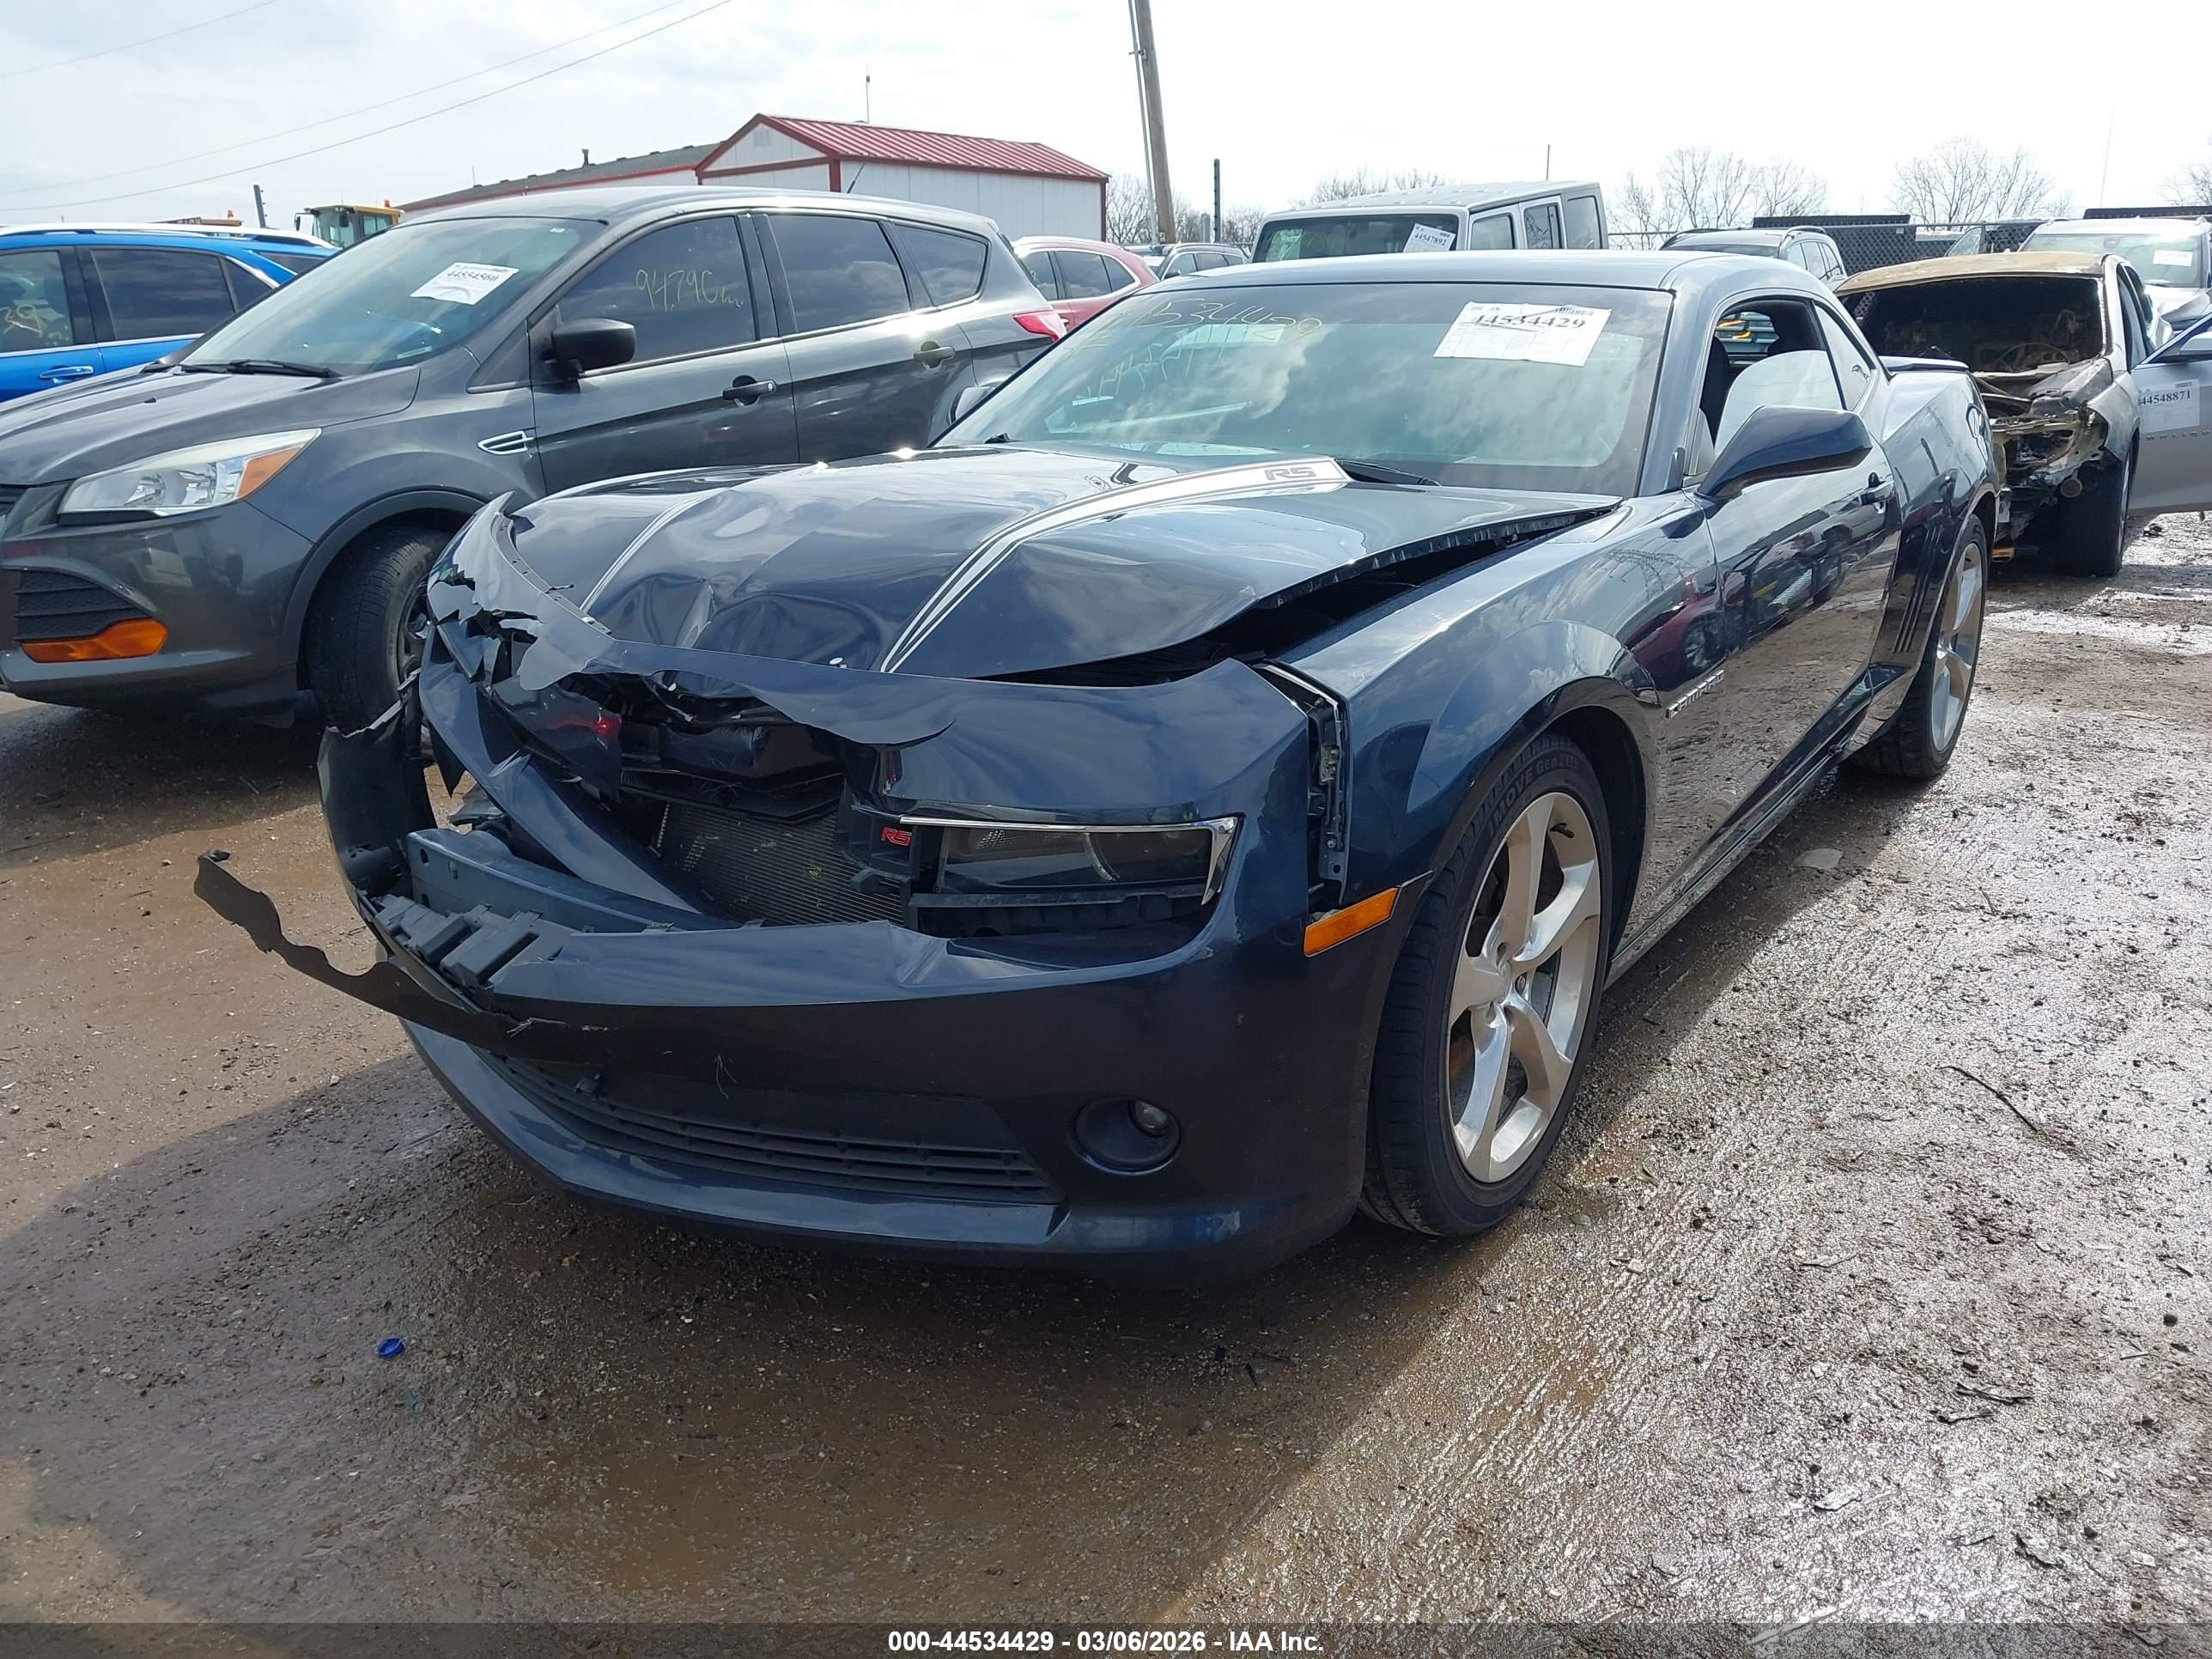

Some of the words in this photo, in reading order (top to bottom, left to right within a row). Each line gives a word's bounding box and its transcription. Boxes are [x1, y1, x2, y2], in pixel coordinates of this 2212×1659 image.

[1471, 314, 1587, 329] 44534429
[1264, 466, 1317, 481] RS
[1666, 669, 1725, 719] CAMARO
[880, 827, 913, 847] RS
